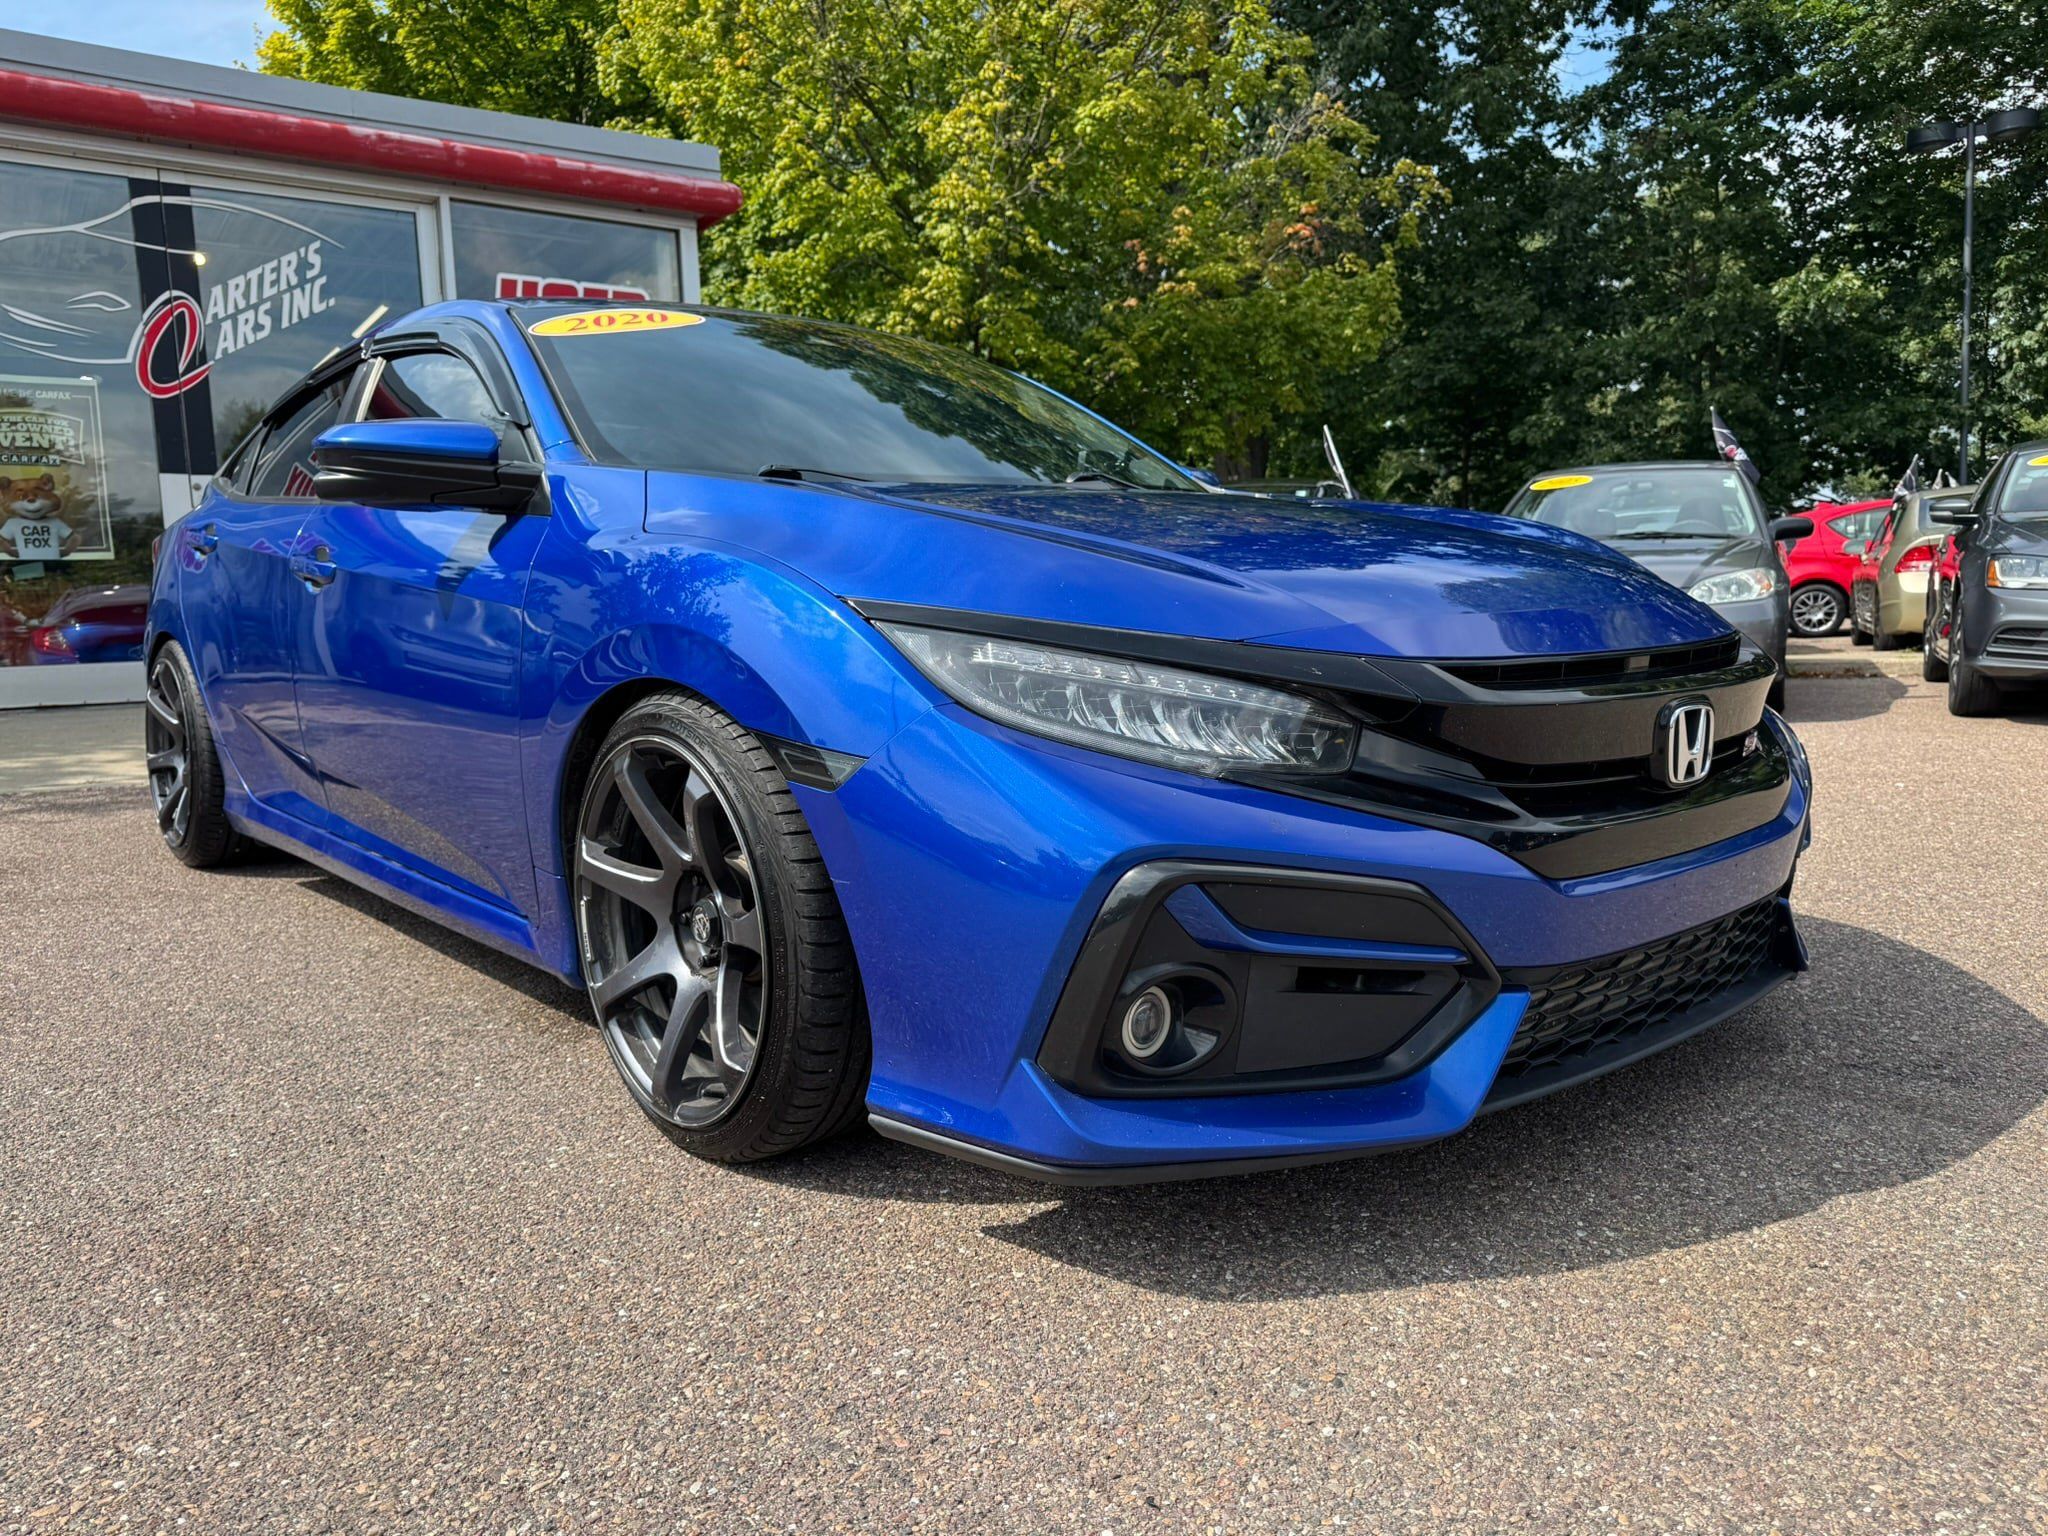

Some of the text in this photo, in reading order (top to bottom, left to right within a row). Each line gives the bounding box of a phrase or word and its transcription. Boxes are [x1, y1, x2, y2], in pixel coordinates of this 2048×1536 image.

[281, 275, 336, 330] INC.
[565, 312, 668, 332] 2020
[35, 390, 71, 400] CARFAX
[0, 422, 75, 436] E-OWNED
[0, 432, 76, 452] VENT!
[1, 454, 60, 465] CARFAX
[21, 526, 51, 537] CAR
[24, 538, 51, 548] FOX
[670, 720, 707, 751] OUTSIDE
